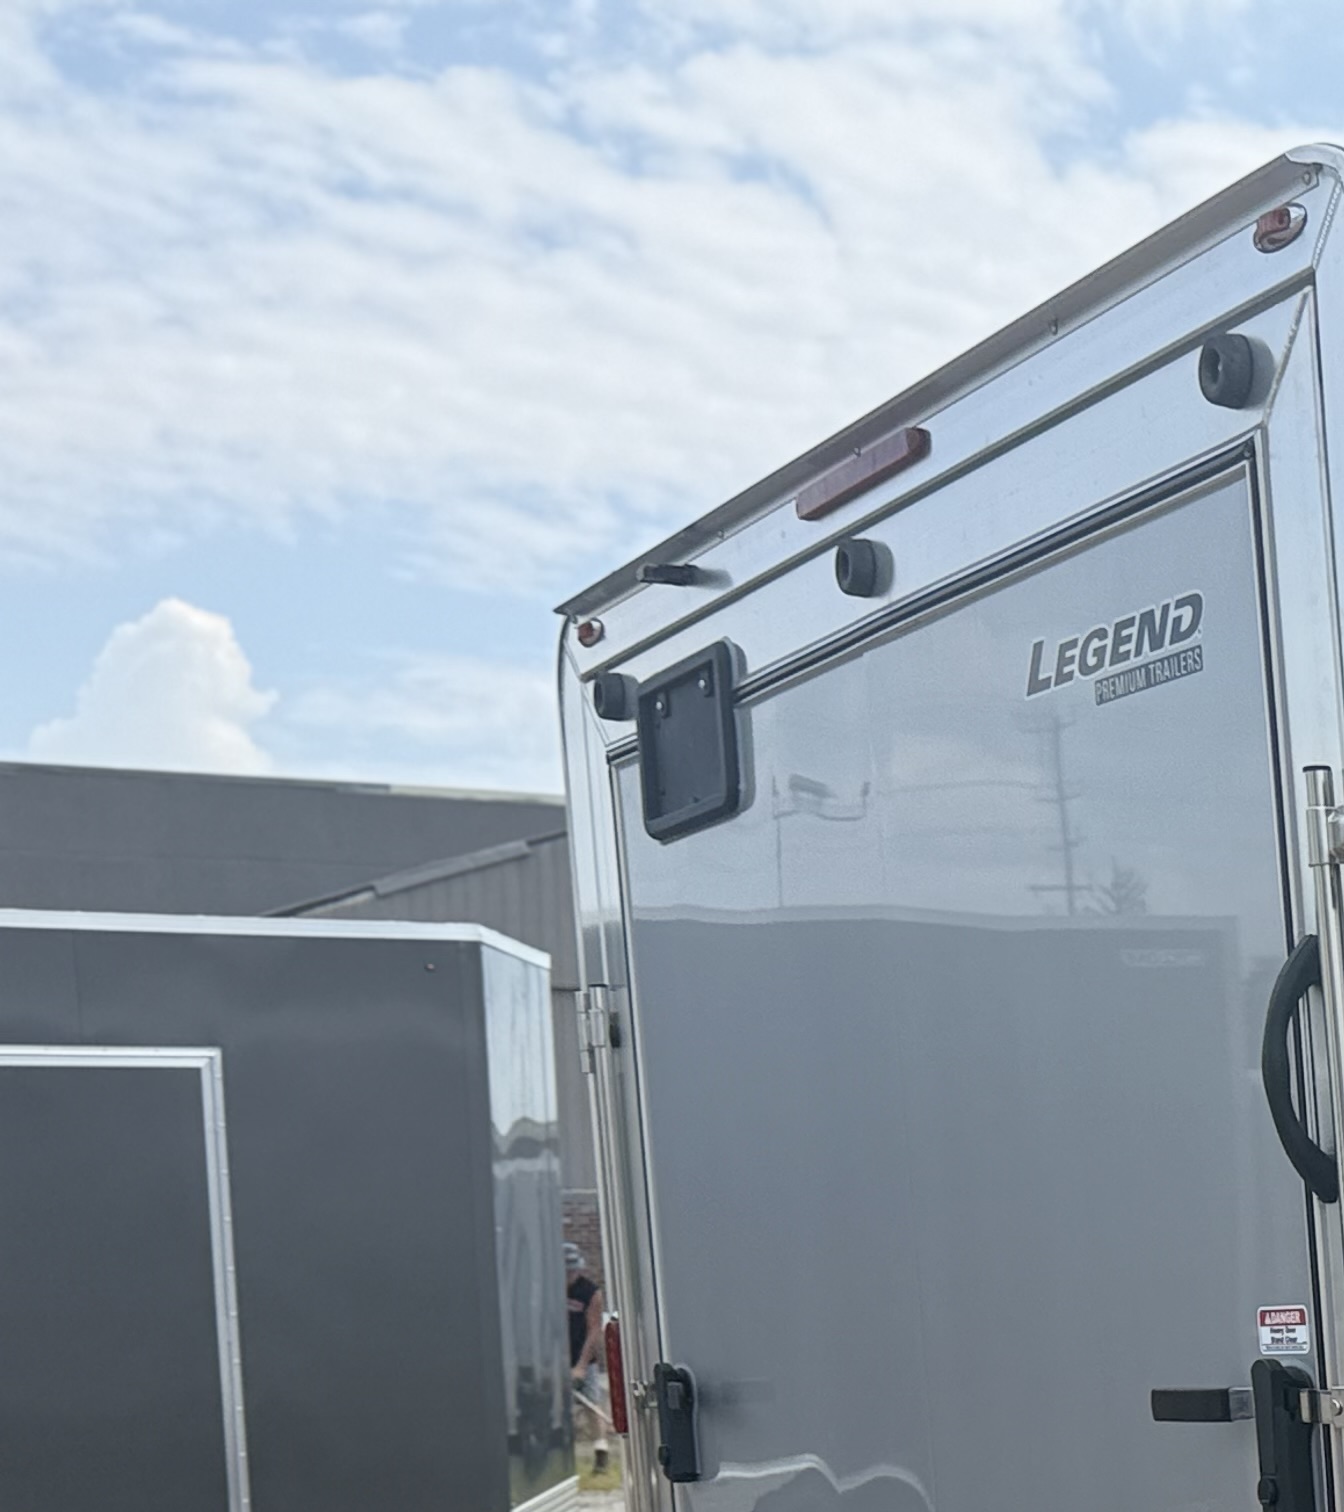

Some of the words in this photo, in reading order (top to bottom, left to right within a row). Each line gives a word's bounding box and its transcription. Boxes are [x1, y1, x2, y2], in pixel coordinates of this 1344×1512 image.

[1026, 592, 1203, 697] LEGEND
[1095, 669, 1147, 701] PREMIUM
[1148, 648, 1201, 684] TRAILERS
[1271, 1310, 1301, 1325] DANGER
